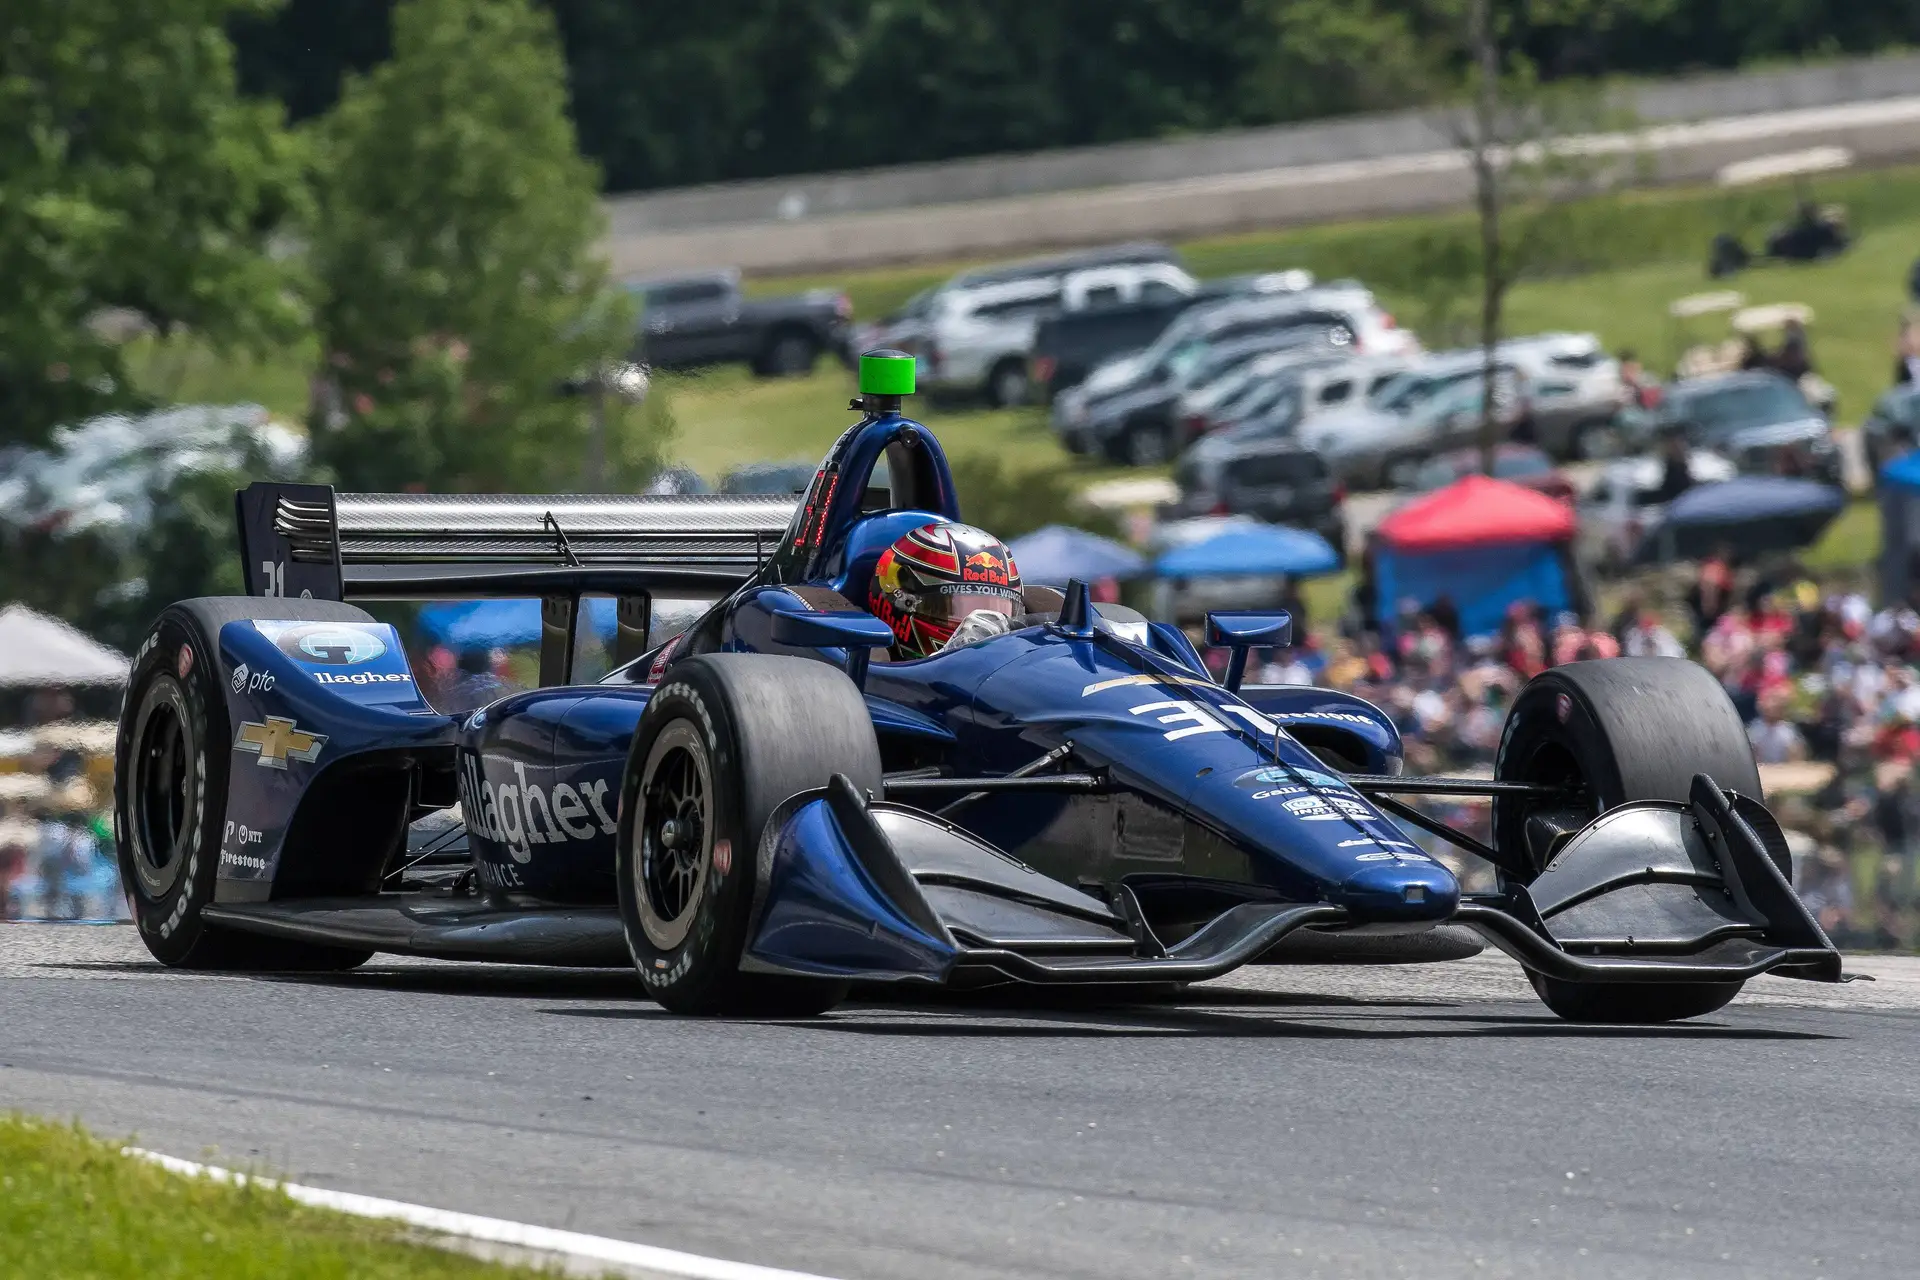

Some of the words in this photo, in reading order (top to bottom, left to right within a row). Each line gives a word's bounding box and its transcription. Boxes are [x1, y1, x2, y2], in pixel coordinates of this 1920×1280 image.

[963, 568, 988, 582] Red
[988, 570, 1009, 587] Bull
[940, 585, 973, 595] GIVES
[975, 585, 998, 596] YOU
[248, 669, 275, 694] ptc
[314, 671, 412, 684] llagher
[1128, 700, 1290, 742] 31
[1267, 711, 1374, 725] irestone
[460, 753, 618, 864] allagher
[247, 830, 263, 843] NTT
[220, 848, 266, 870] Firestone
